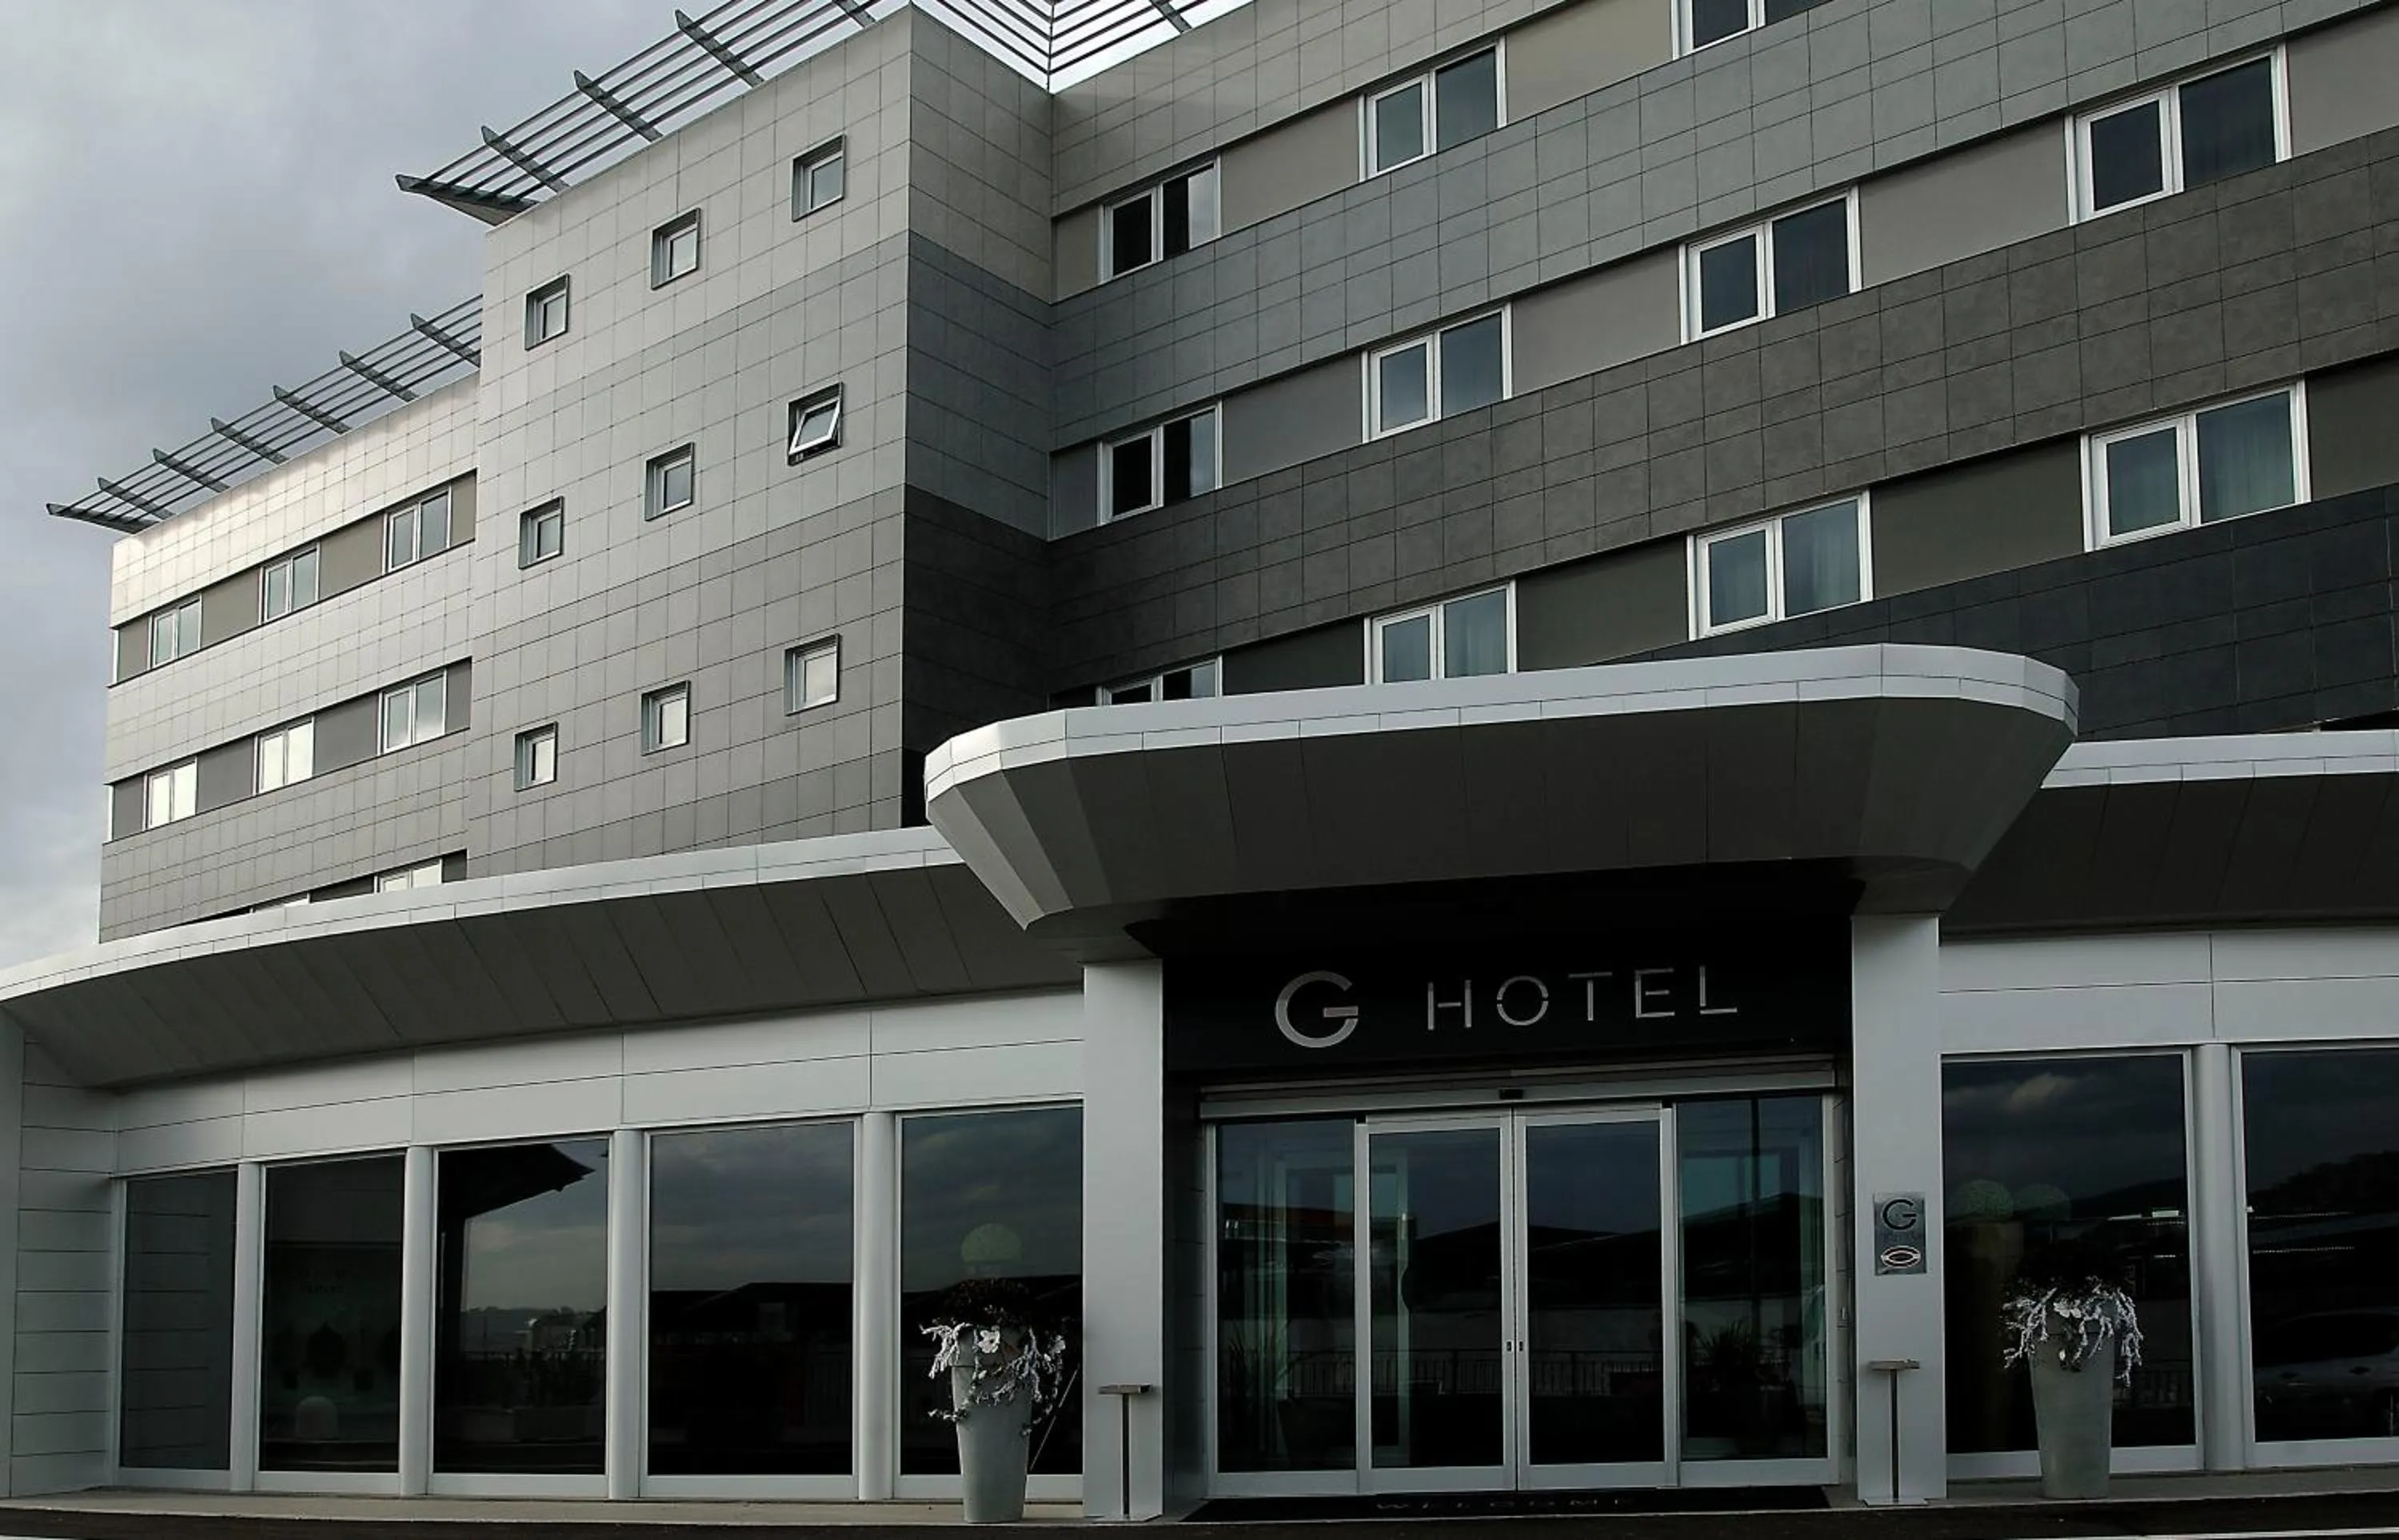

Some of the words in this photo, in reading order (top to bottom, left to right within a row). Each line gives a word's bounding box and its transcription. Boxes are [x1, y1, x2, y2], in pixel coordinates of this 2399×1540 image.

[1275, 970, 1359, 1048] G
[1427, 965, 1738, 1031] HOTEL
[1882, 1199, 1918, 1231] G
